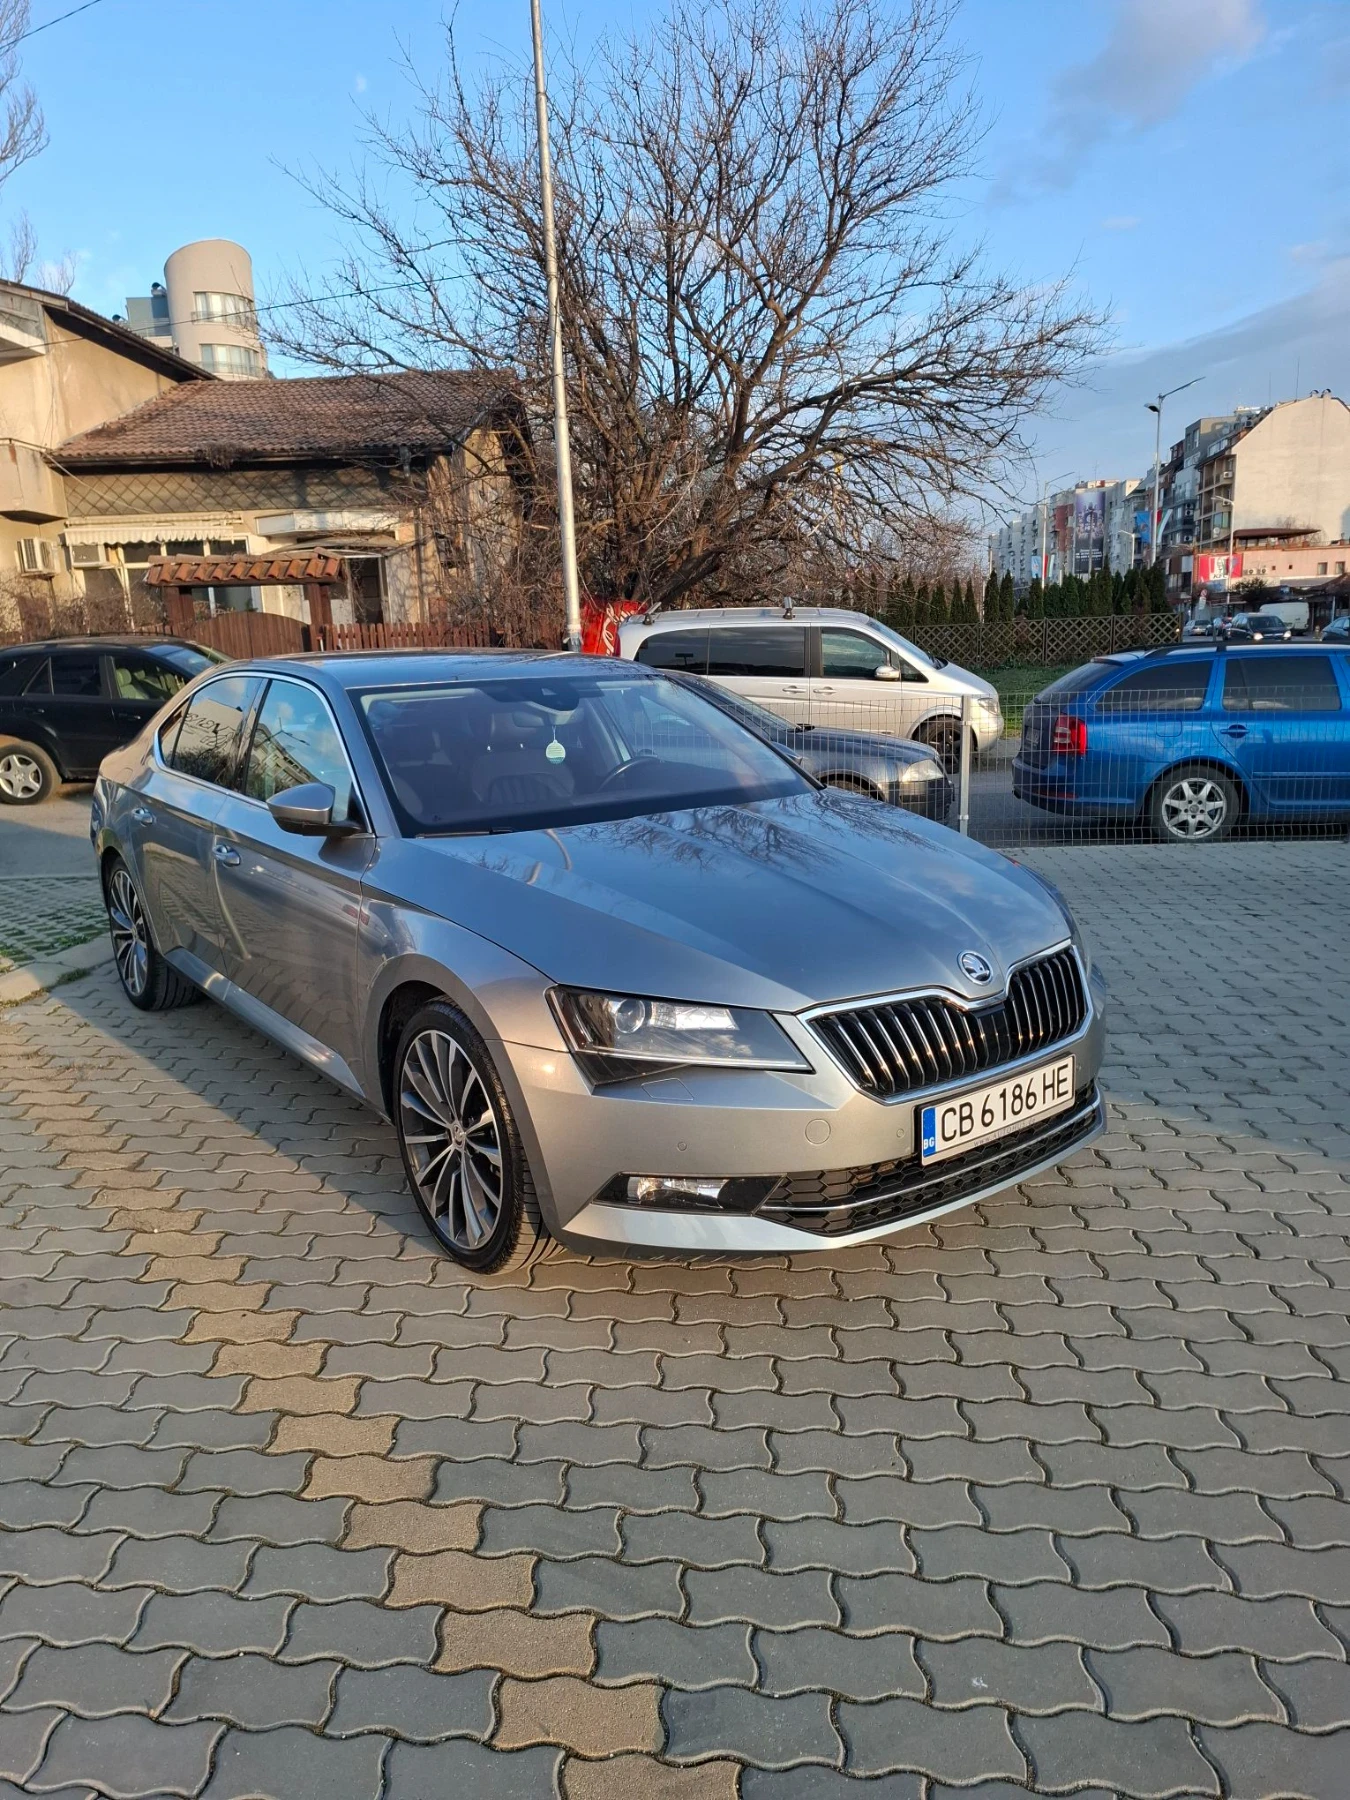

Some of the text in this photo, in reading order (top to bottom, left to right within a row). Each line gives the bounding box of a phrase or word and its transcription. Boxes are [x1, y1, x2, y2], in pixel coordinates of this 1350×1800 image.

[941, 1064, 1069, 1142] CB 6186 HE
[923, 1137, 935, 1150] BG
